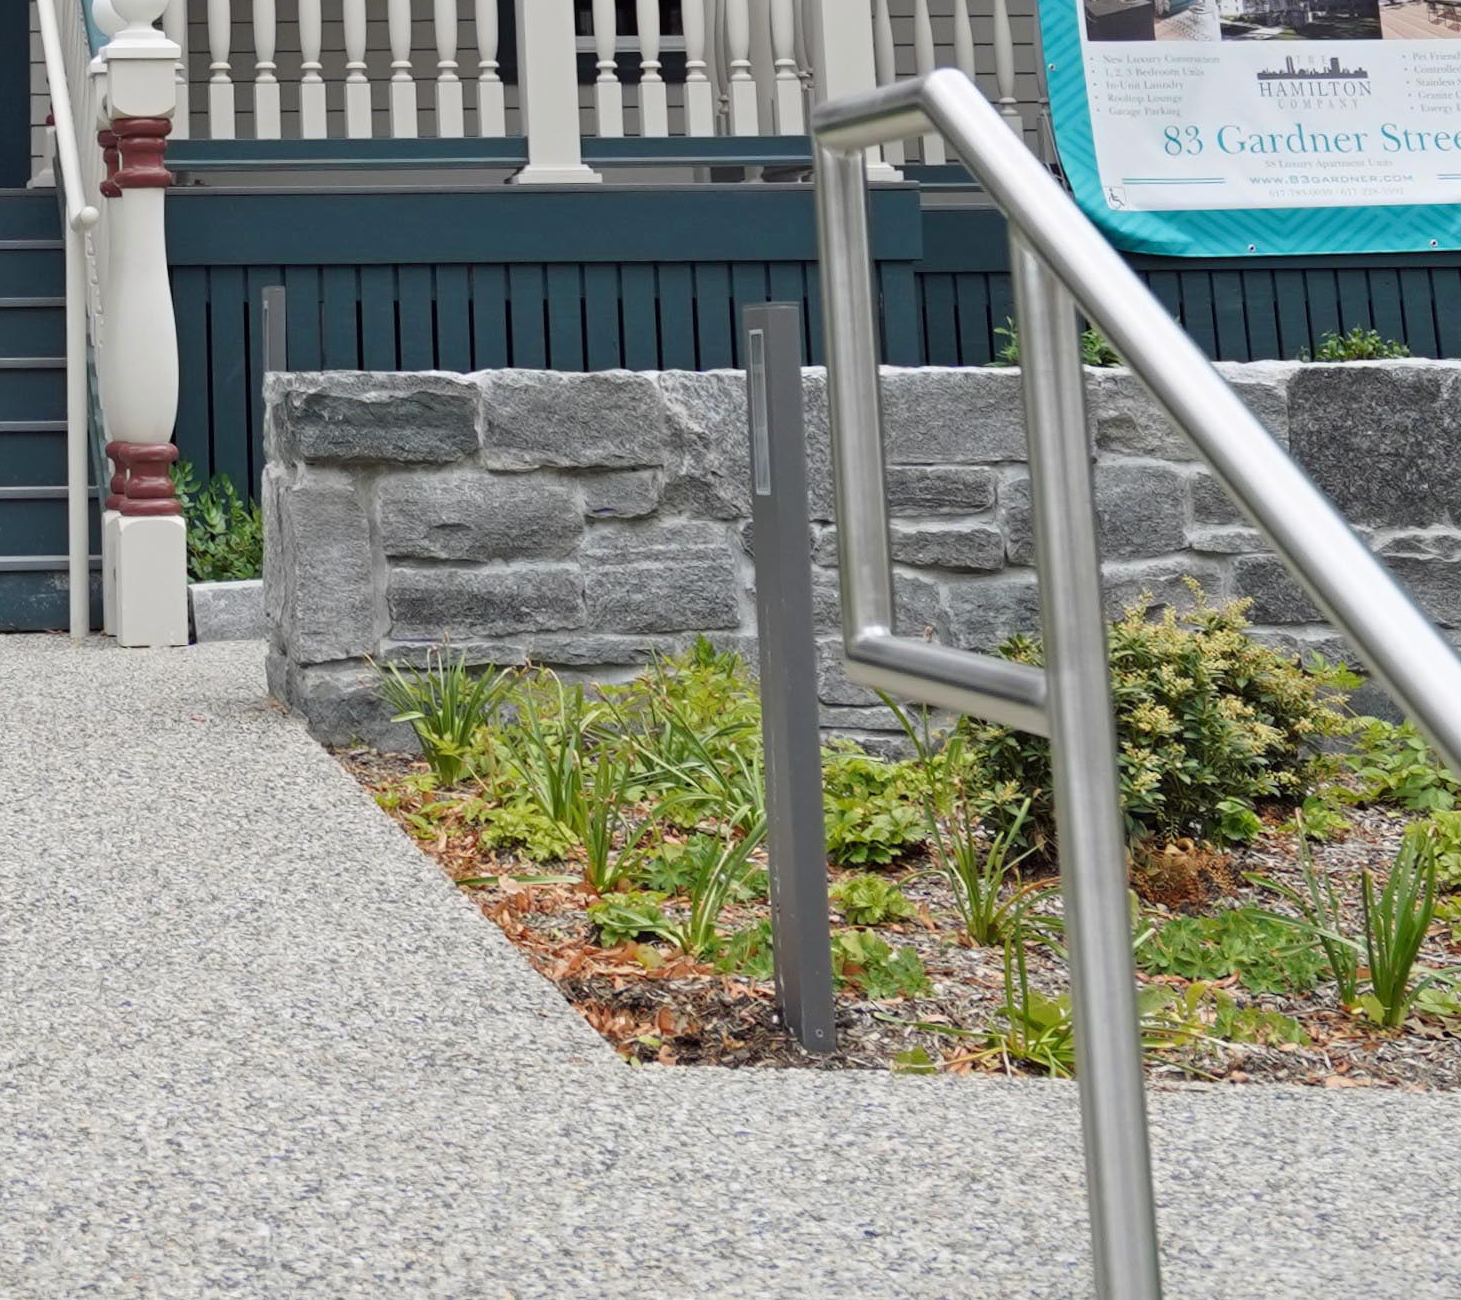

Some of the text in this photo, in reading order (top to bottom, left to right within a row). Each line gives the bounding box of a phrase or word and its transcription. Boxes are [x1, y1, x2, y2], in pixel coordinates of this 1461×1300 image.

[1102, 53, 1220, 65] New Luxury Construction
[1295, 55, 1328, 65] THE
[1412, 51, 1427, 61] Pet
[1135, 67, 1180, 77] Bedroom
[1182, 67, 1205, 77] Units
[1106, 80, 1184, 91] In-Unit Laundry
[1416, 77, 1455, 87] Stainless
[1257, 80, 1372, 98] HAMILTON
[1107, 93, 1183, 105] Rooftop Lounge
[1418, 90, 1453, 100] Granite
[1277, 98, 1358, 110] COMPANY
[1420, 103, 1453, 114] Energy
[1108, 106, 1181, 118] Garage Parking
[1163, 124, 1204, 156] 83
[1216, 122, 1368, 155] Gardner
[1278, 159, 1313, 170] Luxury
[1315, 158, 1365, 169] Apartment
[1367, 157, 1394, 167] Units
